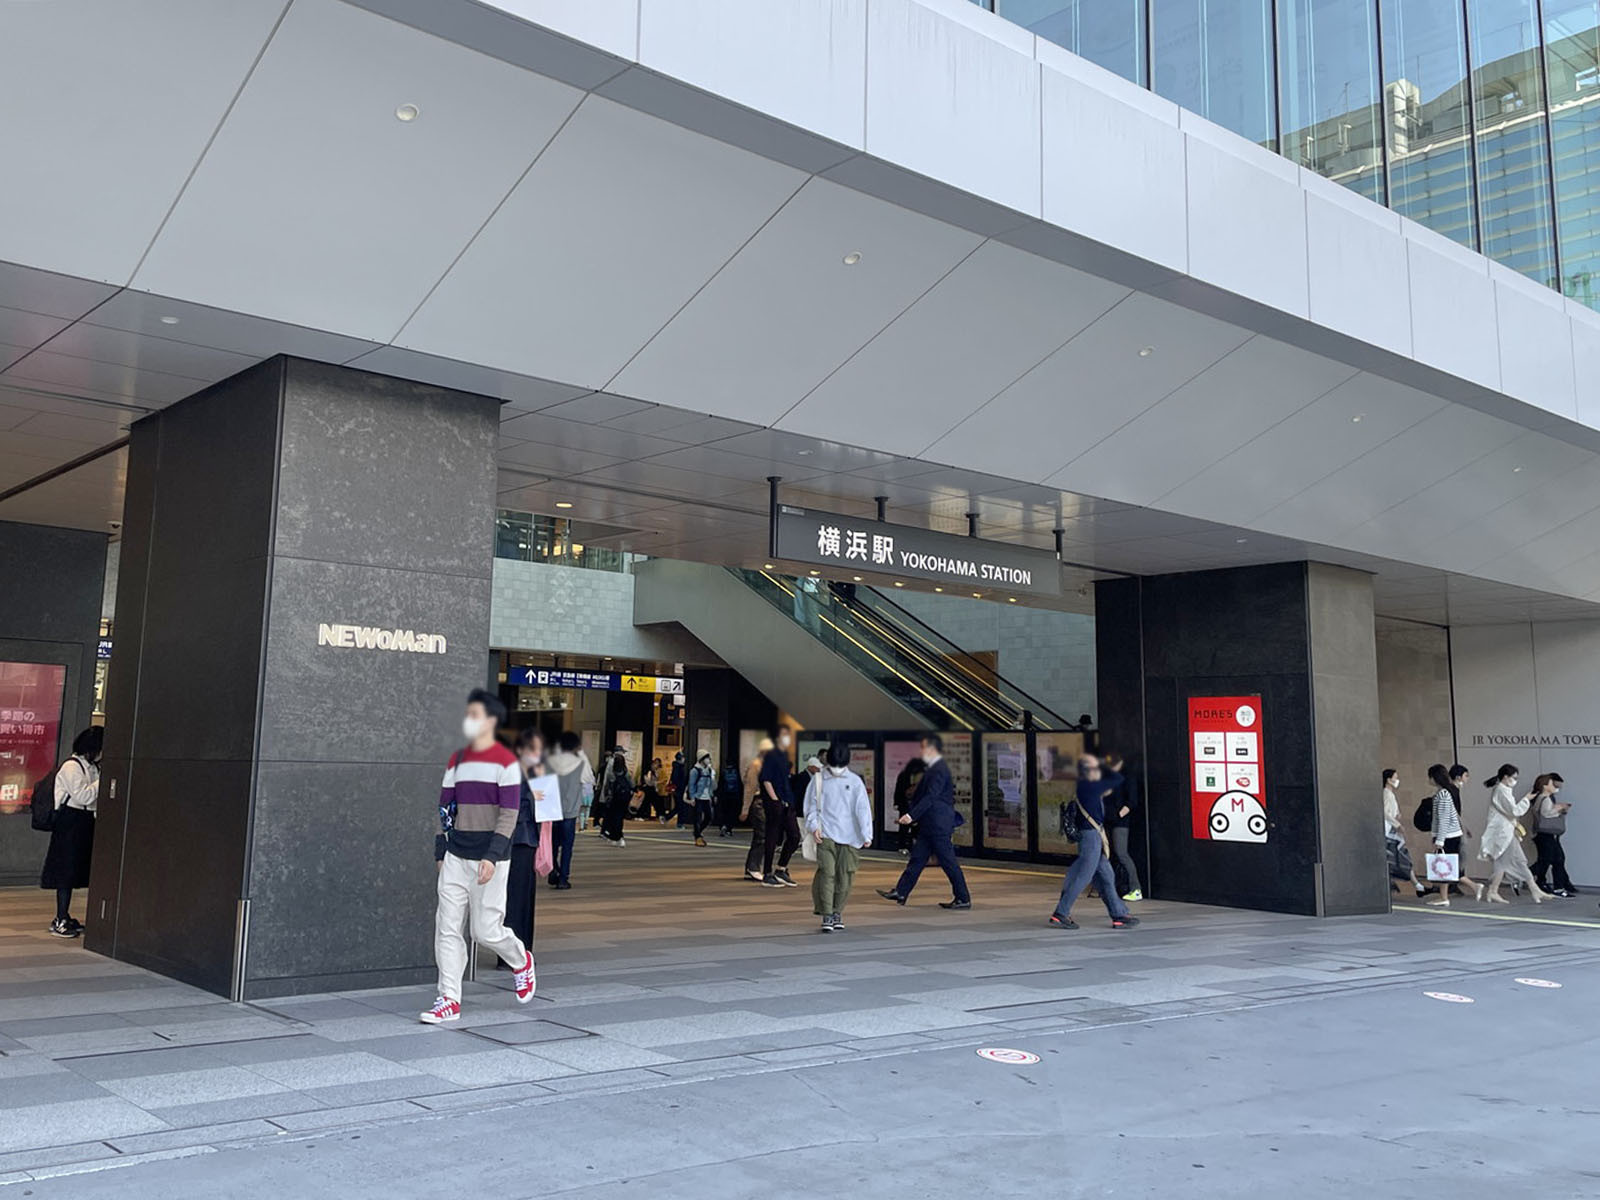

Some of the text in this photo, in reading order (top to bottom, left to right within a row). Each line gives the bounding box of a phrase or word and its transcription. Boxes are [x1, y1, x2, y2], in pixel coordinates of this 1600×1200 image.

[817, 525, 1032, 586] 横浜駅 YOKOHAMA STATION
[318, 623, 447, 654] NEWoMan
[1472, 735, 1485, 746] JR
[1487, 735, 1561, 746] YOKOHAMA
[1231, 798, 1245, 813] M
